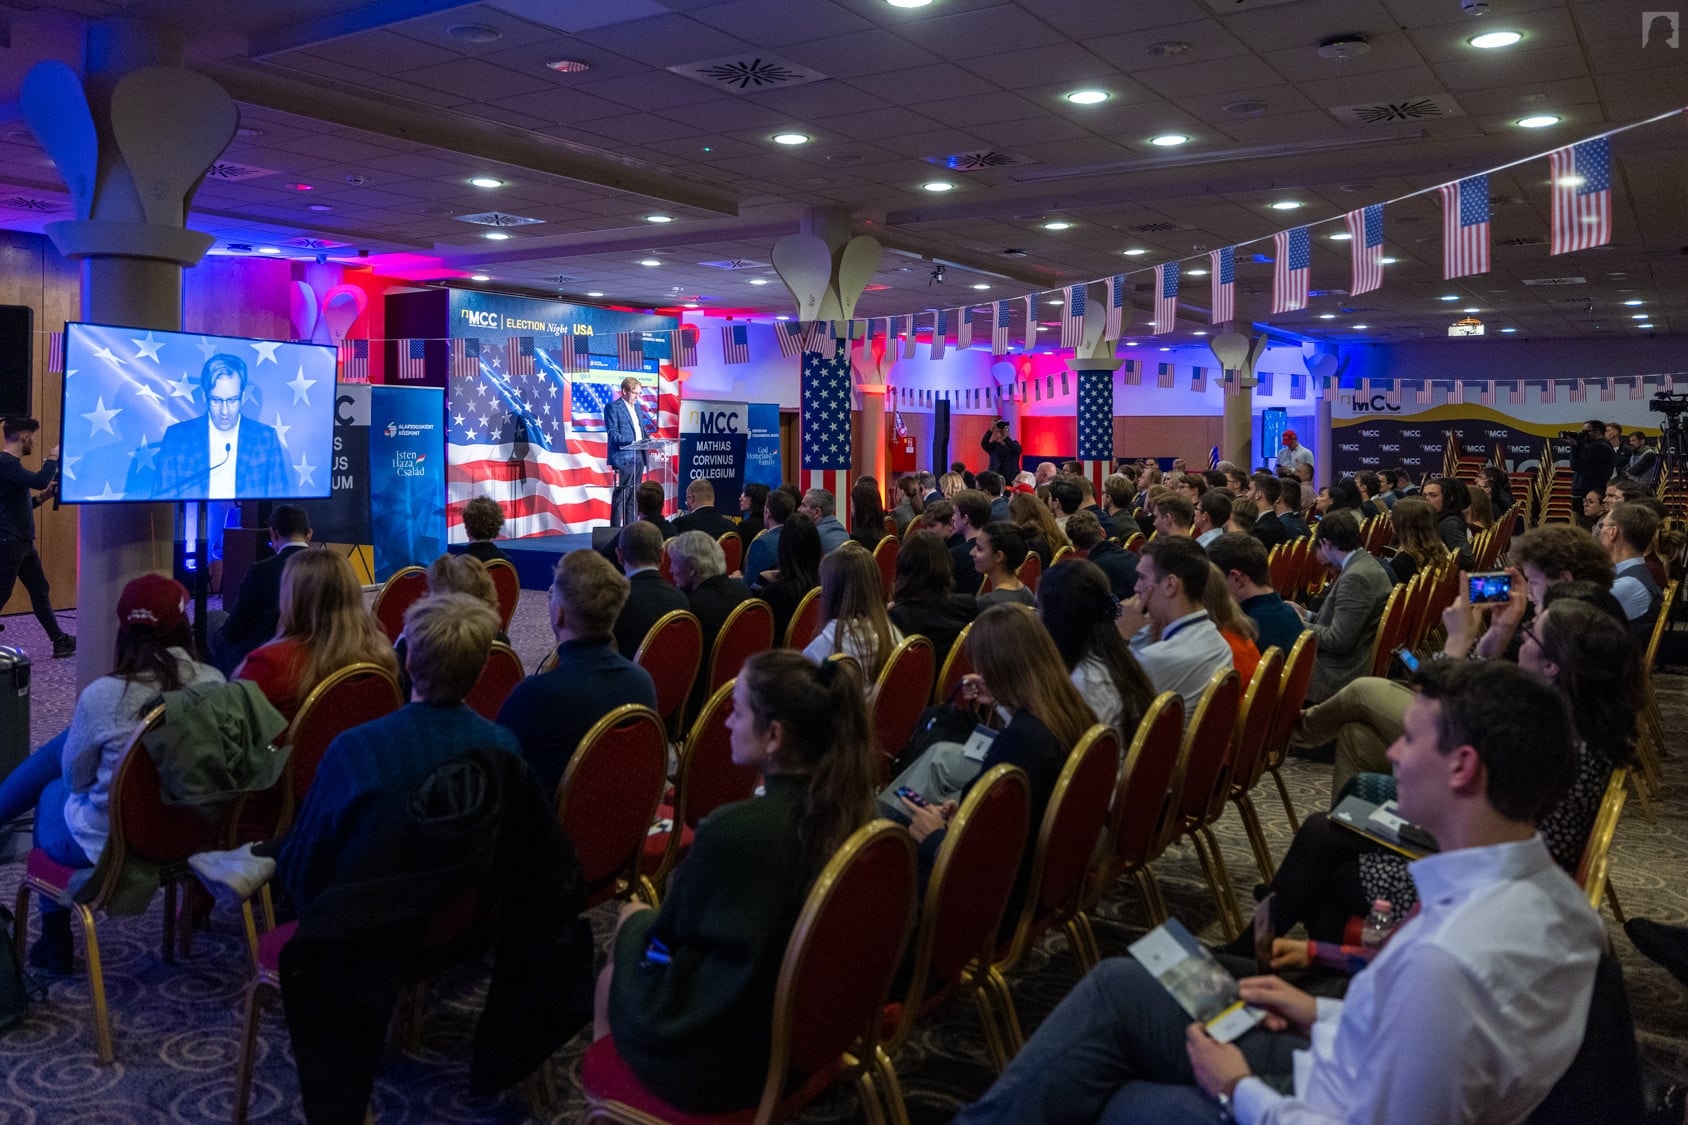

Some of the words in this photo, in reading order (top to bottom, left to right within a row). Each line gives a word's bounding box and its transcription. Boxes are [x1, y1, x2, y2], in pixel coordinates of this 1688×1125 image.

[469, 310, 498, 326] MCC
[506, 318, 546, 331] ELECTION
[546, 322, 568, 336] Night
[573, 323, 594, 336] USA
[700, 411, 739, 434] MCC
[1362, 430, 1380, 438] MCC
[1403, 430, 1421, 438] MCC
[1445, 430, 1464, 438] MC
[1489, 430, 1508, 438] MCC
[696, 440, 732, 452] MATHIAS
[1342, 444, 1360, 452] MCC
[1382, 444, 1400, 452] MCC
[1423, 444, 1442, 452] MCC
[1466, 445, 1486, 453] MCC
[1511, 445, 1530, 453] MCC
[396, 450, 417, 460] Isten
[392, 458, 413, 468] Haza
[692, 454, 734, 466] CORVINUS
[1362, 457, 1380, 465] MCC
[1403, 457, 1421, 465] MCC
[396, 466, 425, 477] Család
[689, 468, 736, 480] COLLEGIUM
